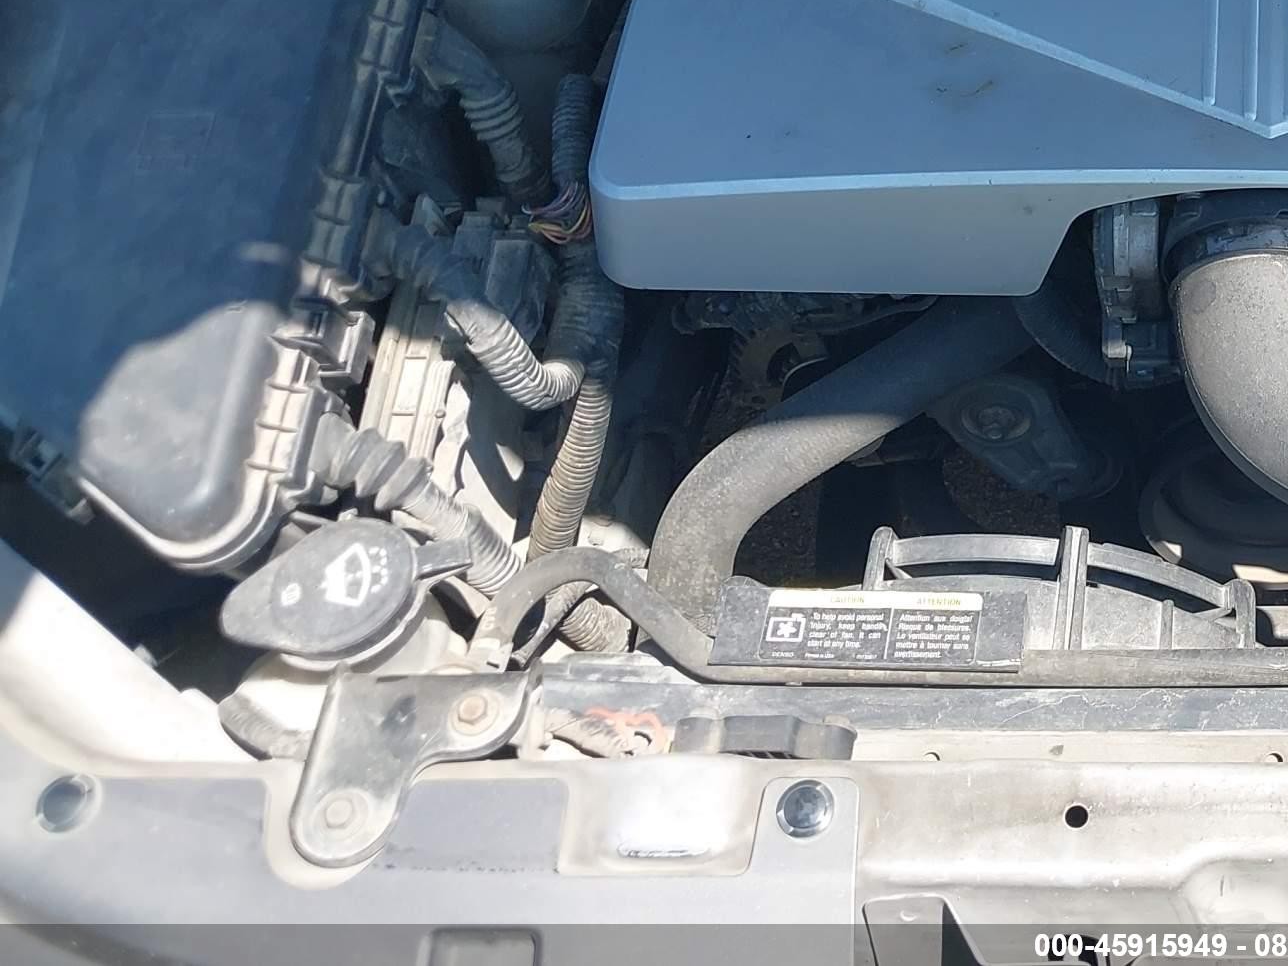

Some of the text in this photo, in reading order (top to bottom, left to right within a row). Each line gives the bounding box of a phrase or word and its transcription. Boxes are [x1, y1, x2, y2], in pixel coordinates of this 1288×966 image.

[916, 597, 961, 606] ATTENTION
[812, 611, 884, 622] To help avoid personal
[900, 614, 931, 622] Attention
[925, 623, 934, 631] de
[830, 631, 838, 639] of
[807, 640, 822, 648] start
[832, 641, 844, 650] any
